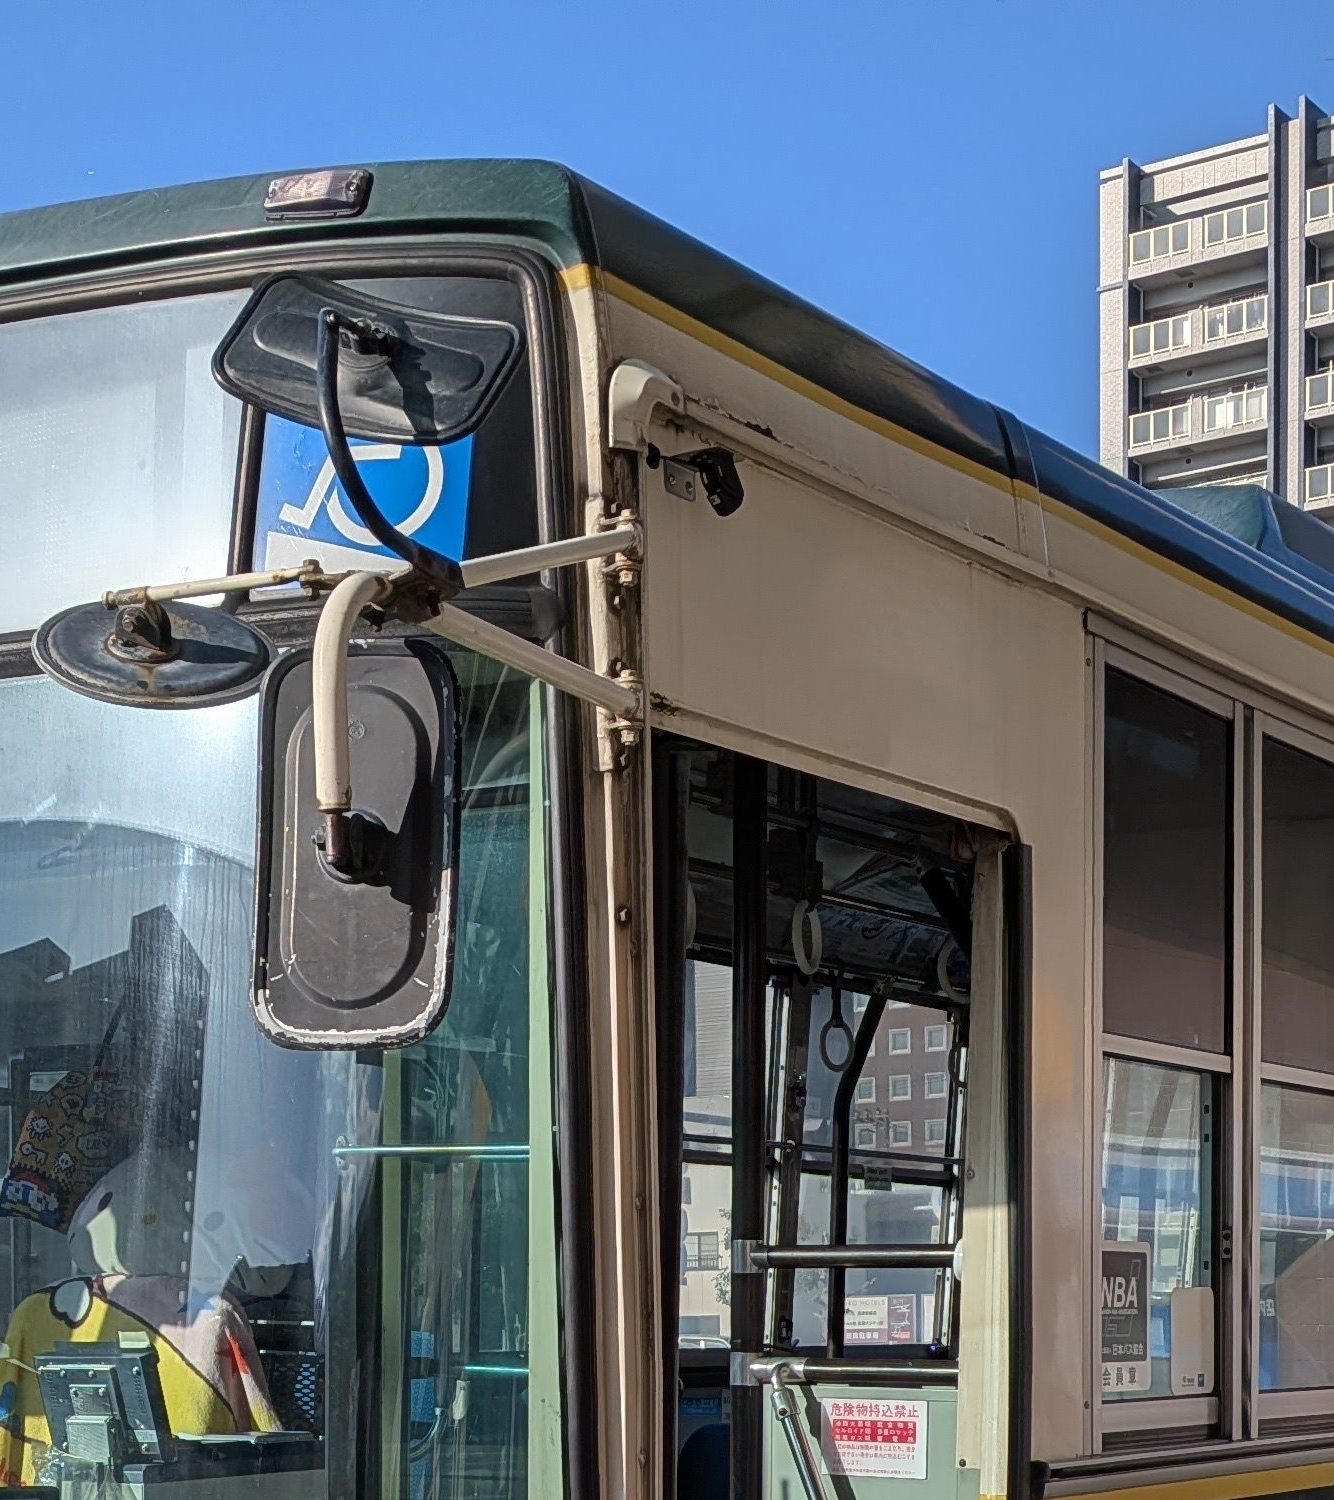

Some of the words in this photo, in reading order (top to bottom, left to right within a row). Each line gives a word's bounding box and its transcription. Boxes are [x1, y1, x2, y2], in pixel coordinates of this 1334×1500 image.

[1102, 1276, 1138, 1308] NBA
[831, 1403, 919, 1418] 危険物持込禁止
